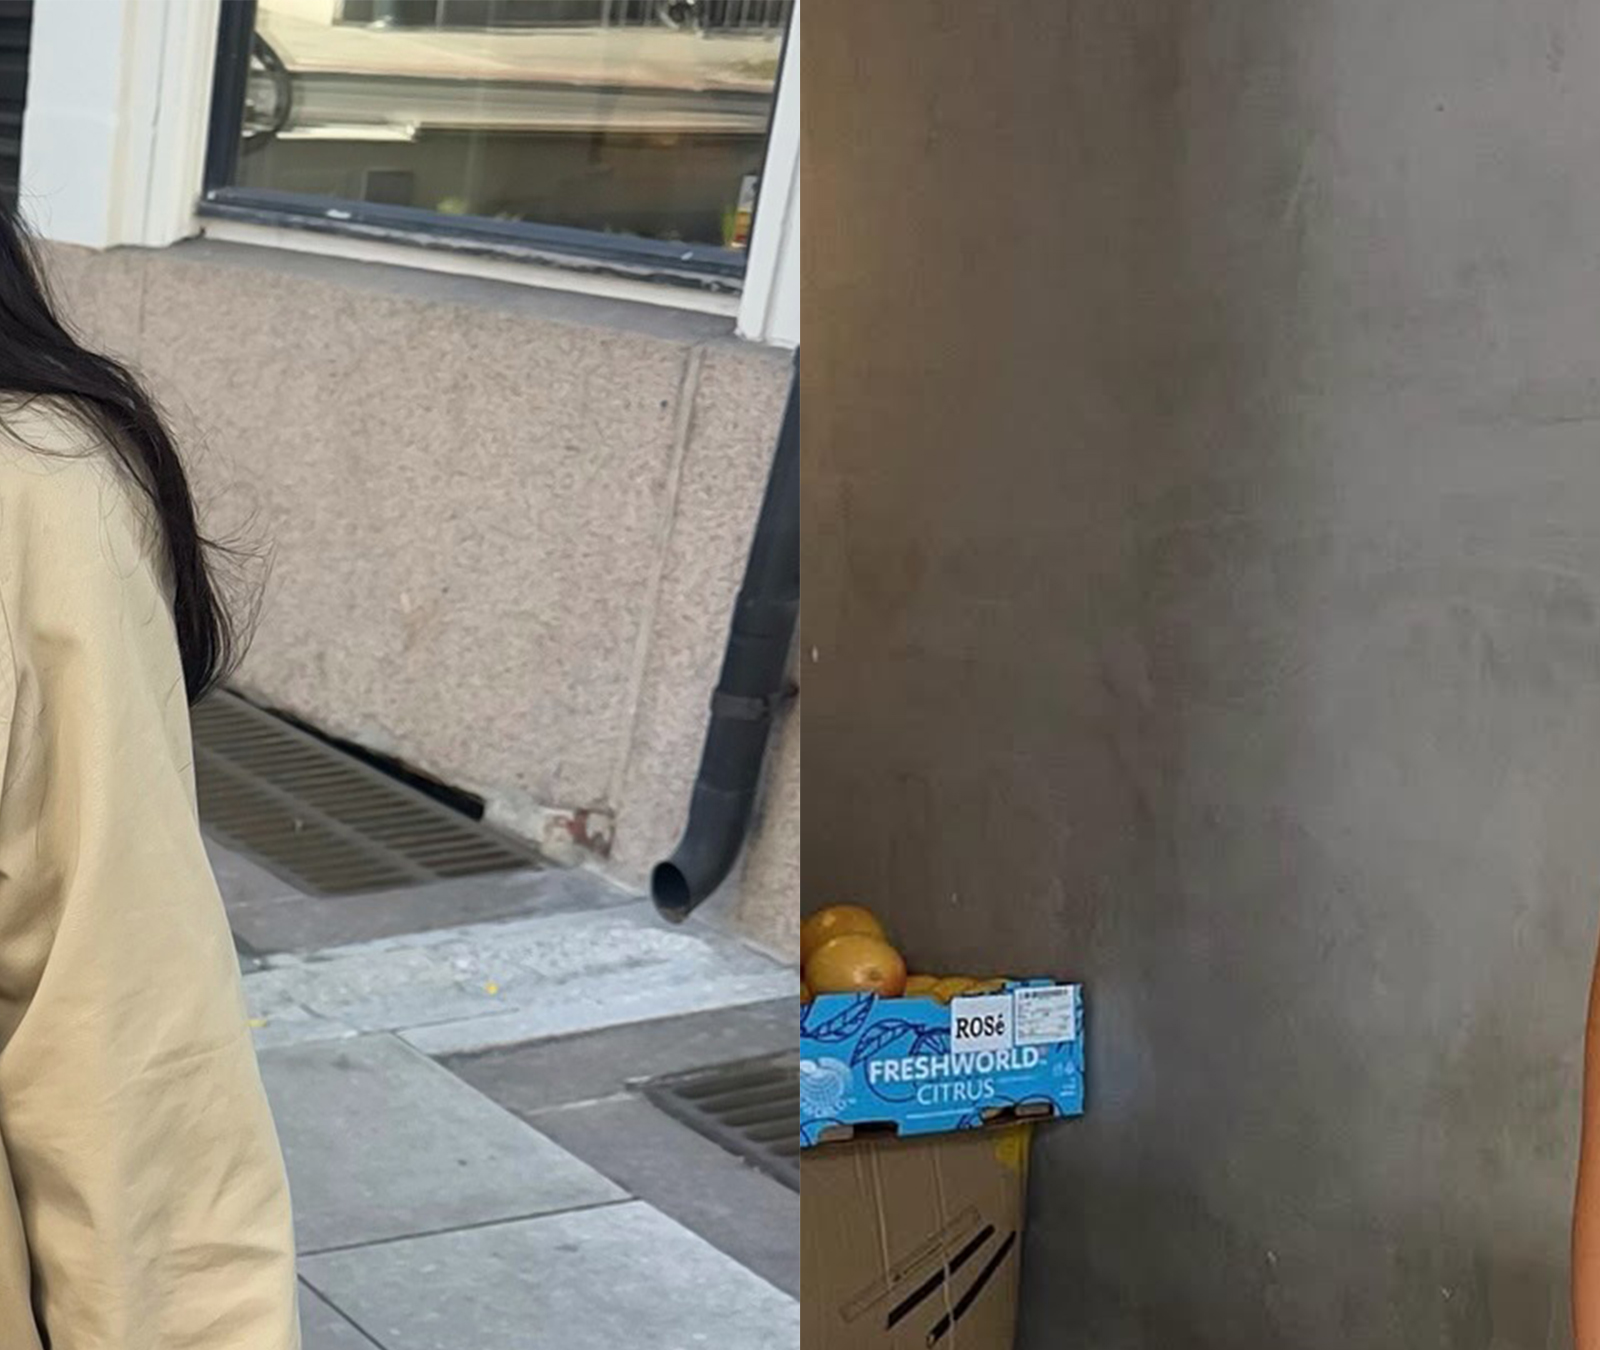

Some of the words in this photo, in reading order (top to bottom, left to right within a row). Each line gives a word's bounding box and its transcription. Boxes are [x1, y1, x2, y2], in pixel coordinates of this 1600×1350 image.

[955, 1014, 1005, 1040] ROSé
[869, 1046, 1040, 1084] FRESHWORLD
[916, 1078, 996, 1106] CITRUS
